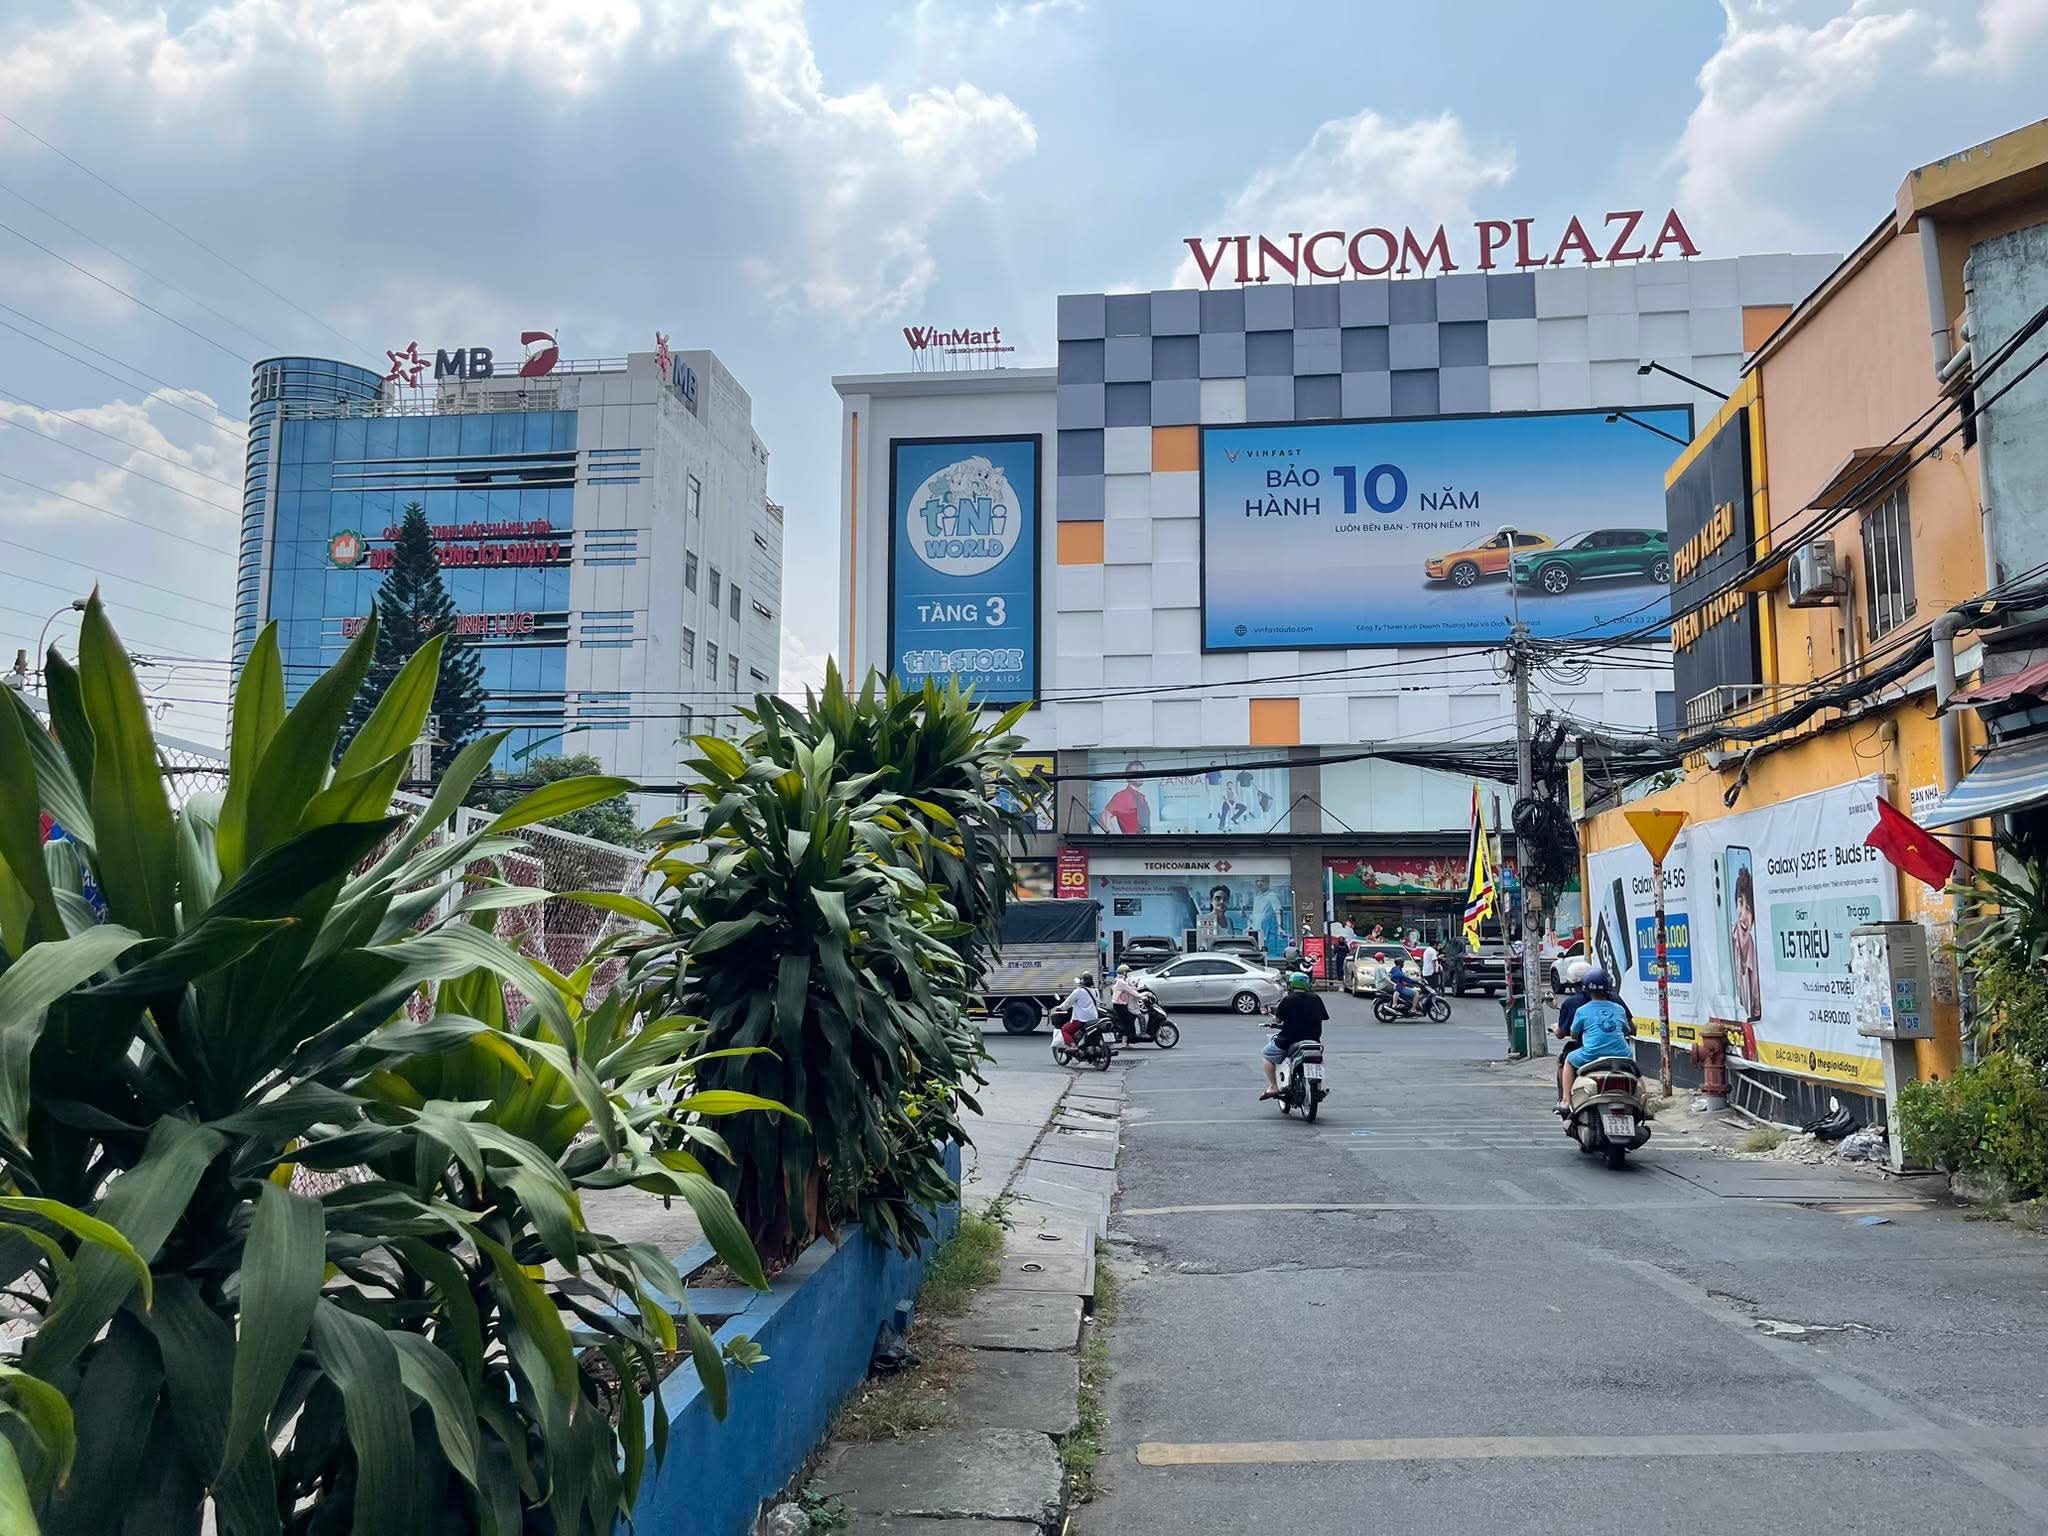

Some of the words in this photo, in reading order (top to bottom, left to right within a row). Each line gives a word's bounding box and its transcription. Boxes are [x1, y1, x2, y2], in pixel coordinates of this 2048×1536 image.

[1184, 224, 1458, 285] VINCOM
[1474, 208, 1702, 270] PLAZA
[903, 326, 1000, 350] WinMart
[434, 347, 494, 379] MB
[672, 355, 699, 401] MB
[1247, 449, 1302, 458] VINFAST
[1266, 464, 1320, 487] BẢO
[1333, 464, 1408, 514] 10
[1420, 486, 1479, 511] NĂM
[1245, 493, 1320, 517] HÀNH
[1465, 520, 1480, 528] TIN
[549, 542, 560, 562] 9
[925, 540, 1004, 559] WORLD
[1674, 533, 1700, 584] PHỤ
[1701, 501, 1735, 556] KIỆN
[918, 601, 977, 622] TẦNG
[986, 597, 1006, 626] 3
[1253, 625, 1313, 634] vinfastauto.com
[906, 677, 924, 685] THE
[997, 675, 1021, 683] KIDS
[1848, 802, 1873, 815] SAMSUNG
[1144, 862, 1210, 870] TECHCOMBANK
[1768, 856, 1799, 879] Galaxy
[1801, 851, 1816, 872] S23
[1818, 848, 1827, 868] FE
[1835, 844, 1861, 866] Buds
[1061, 872, 1085, 886] 50
[1673, 867, 1686, 889] 5G
[1780, 931, 1796, 959] 1.5
[1799, 921, 1829, 968] TRIỆU
[1831, 980, 1836, 994] 2
[1817, 1058, 1858, 1078] thegioididong
